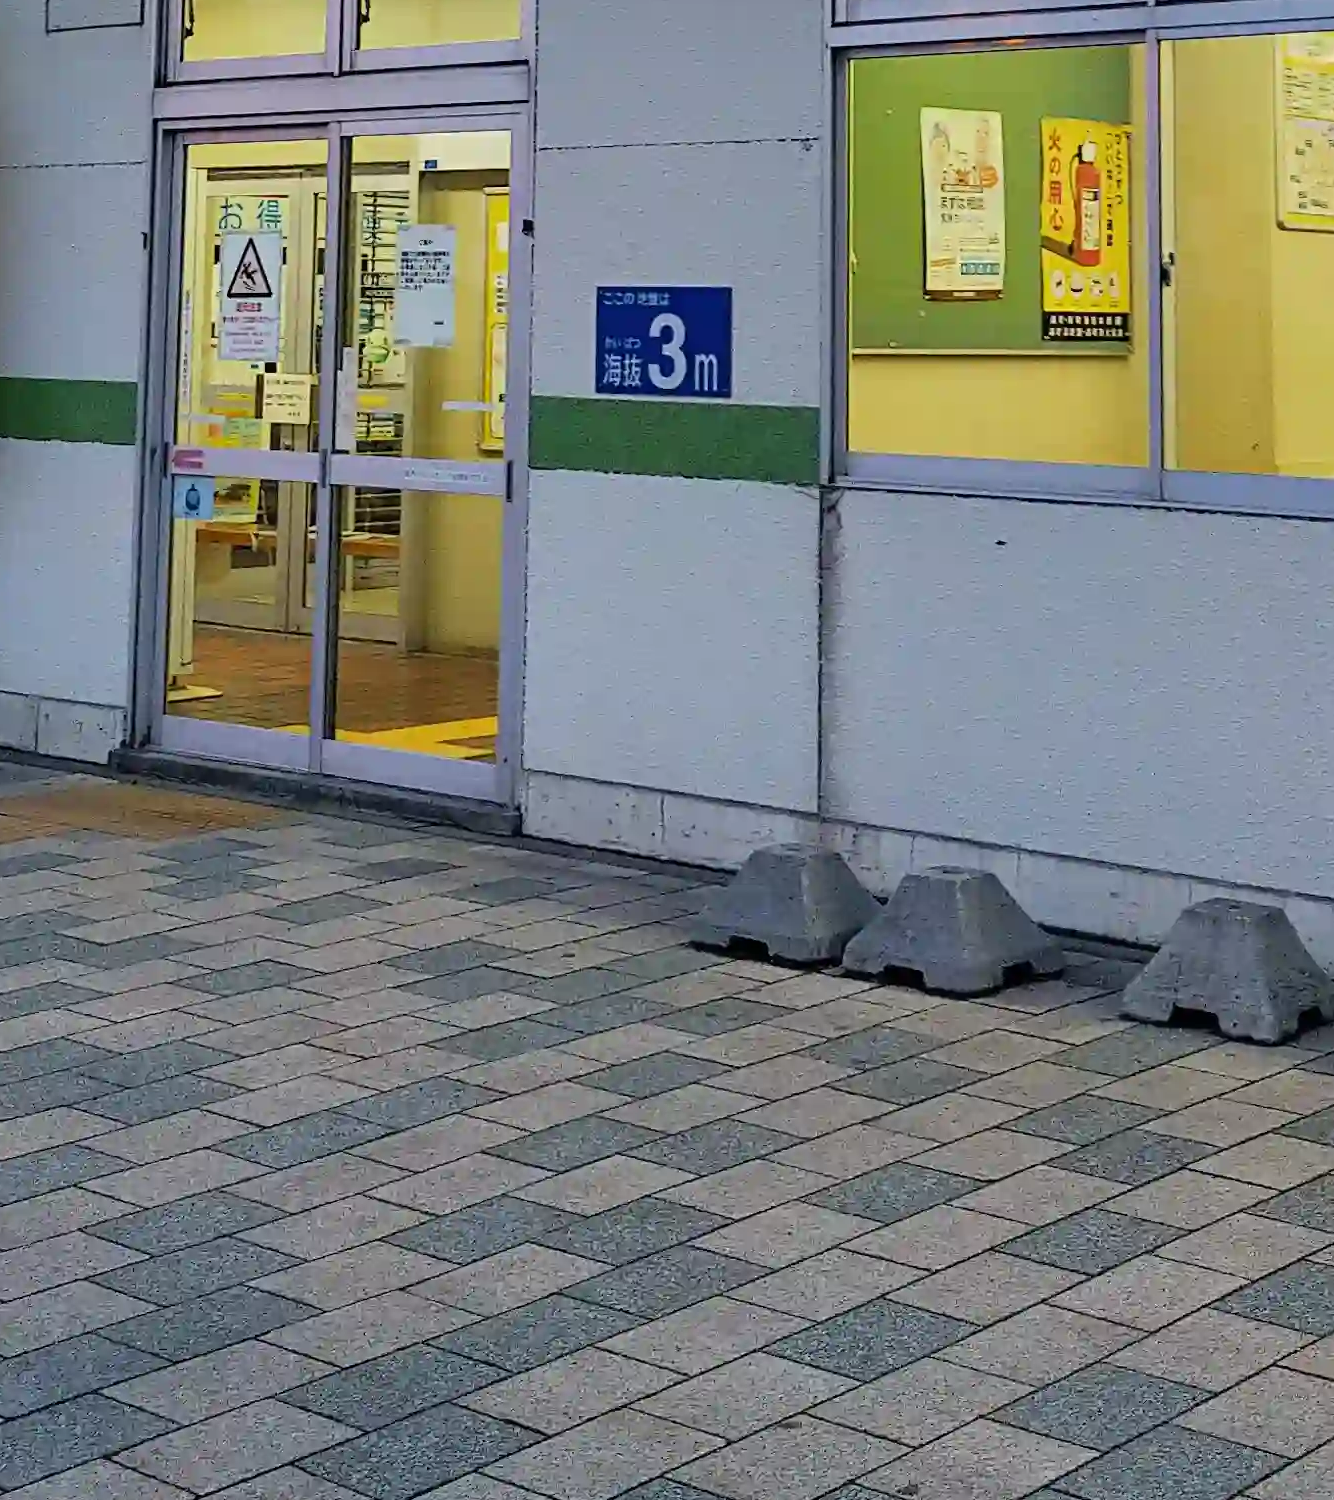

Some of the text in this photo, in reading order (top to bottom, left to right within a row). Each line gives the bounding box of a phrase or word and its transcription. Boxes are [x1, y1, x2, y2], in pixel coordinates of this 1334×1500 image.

[1048, 128, 1064, 232] 火の用心
[603, 313, 718, 391] 海抜 3 m
